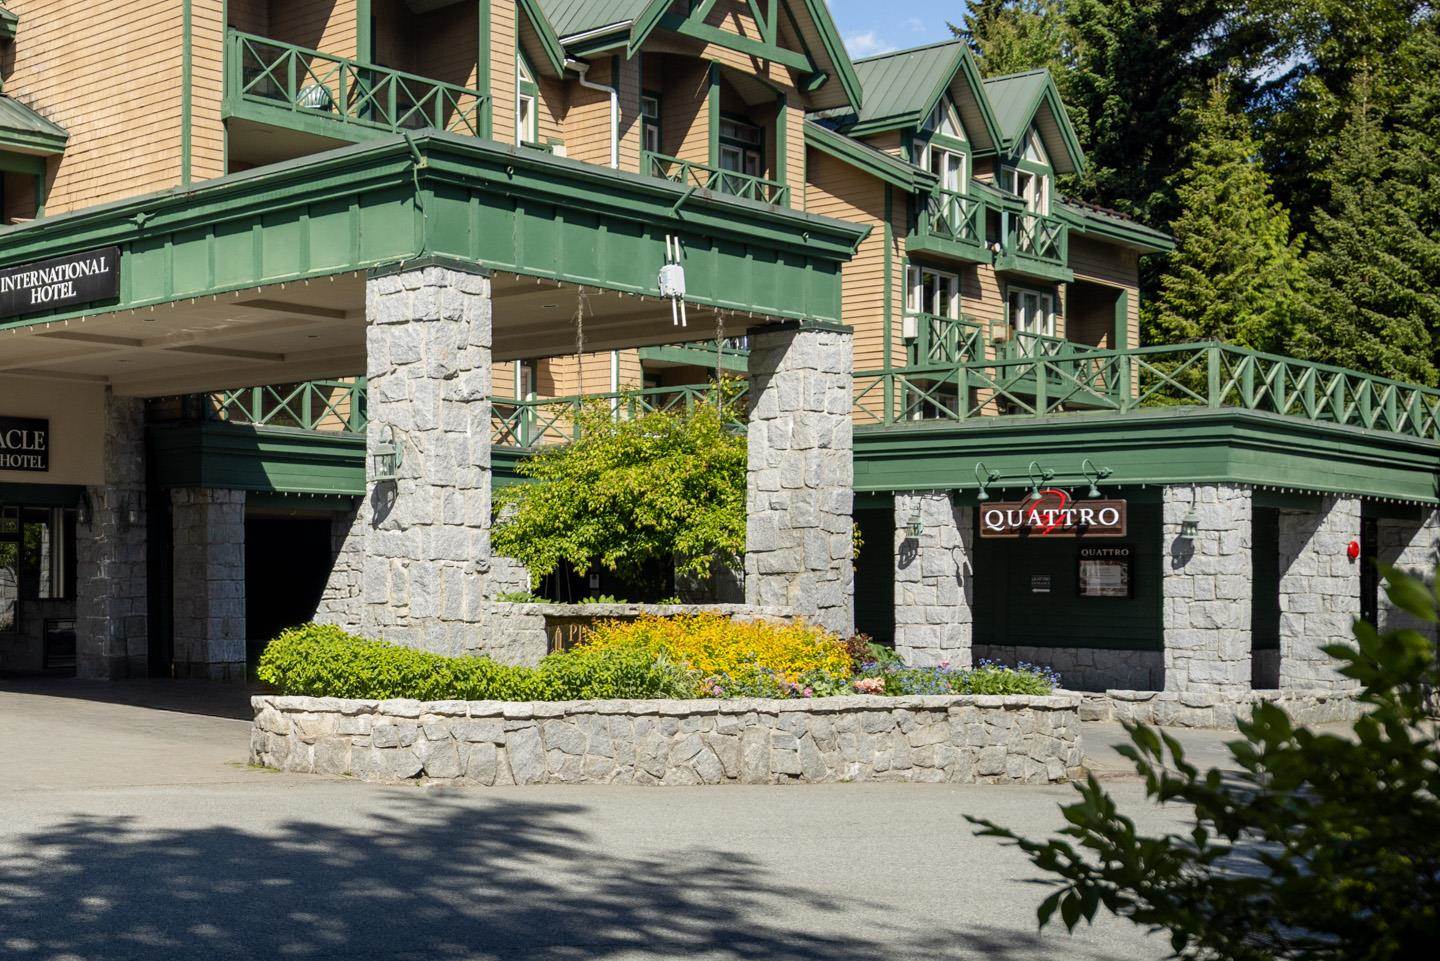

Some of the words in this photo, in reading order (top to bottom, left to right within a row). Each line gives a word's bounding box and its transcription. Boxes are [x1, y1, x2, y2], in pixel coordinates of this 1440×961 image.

[0, 256, 109, 293] INTERNATIONAL
[30, 282, 77, 304] HOTEL
[0, 453, 46, 469] HOTEL
[985, 507, 1119, 531] QUATTRO
[1081, 548, 1129, 556] QUATTRO
